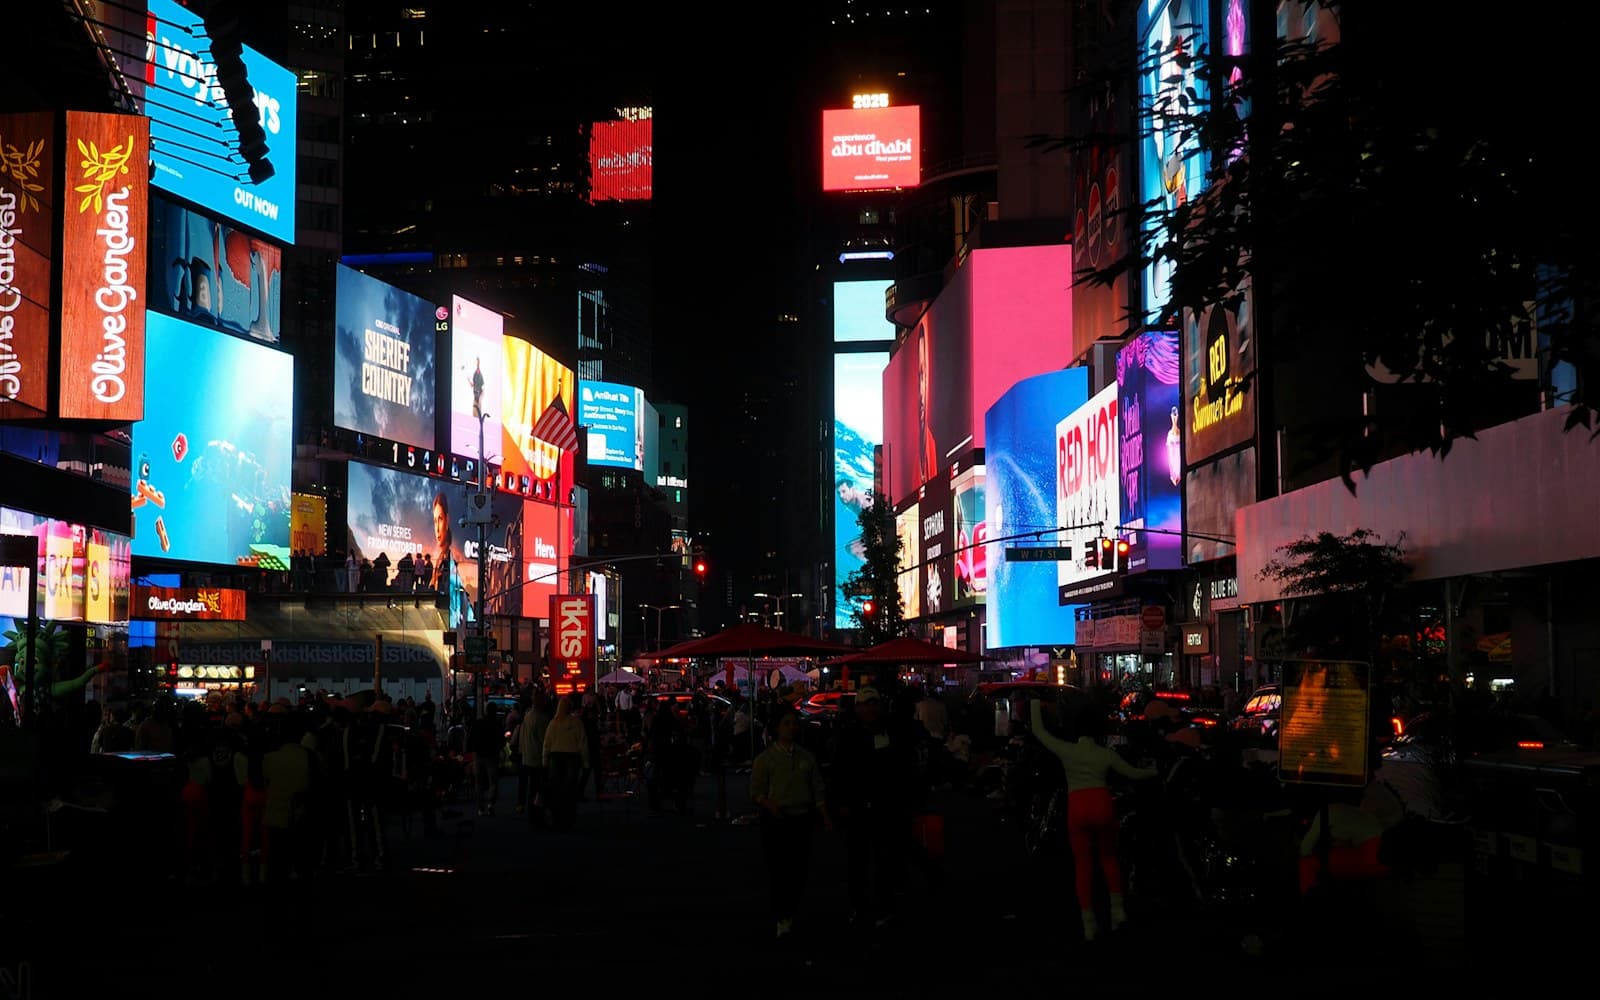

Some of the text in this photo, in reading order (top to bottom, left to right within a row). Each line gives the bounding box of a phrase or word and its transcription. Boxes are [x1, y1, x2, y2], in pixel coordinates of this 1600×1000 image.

[831, 138, 912, 157] abu dhabi
[833, 134, 876, 143] experience
[234, 187, 279, 220] OUT NOW
[91, 186, 136, 403] Olive Garden
[436, 322, 448, 331] LG
[364, 329, 411, 373] SHERIFF
[1209, 334, 1226, 386] RED
[362, 362, 412, 407] COUNTRY
[392, 442, 445, 474] 1540
[1058, 424, 1084, 498] RED
[1086, 399, 1118, 486] HOT
[378, 523, 412, 540] NEW SERIES
[923, 509, 945, 541] SEPHORA
[535, 537, 557, 561] Hero.
[1020, 550, 1030, 559] W
[148, 595, 207, 614] Olive Garden
[1210, 580, 1227, 600] BLUE
[560, 598, 589, 658] tkts
